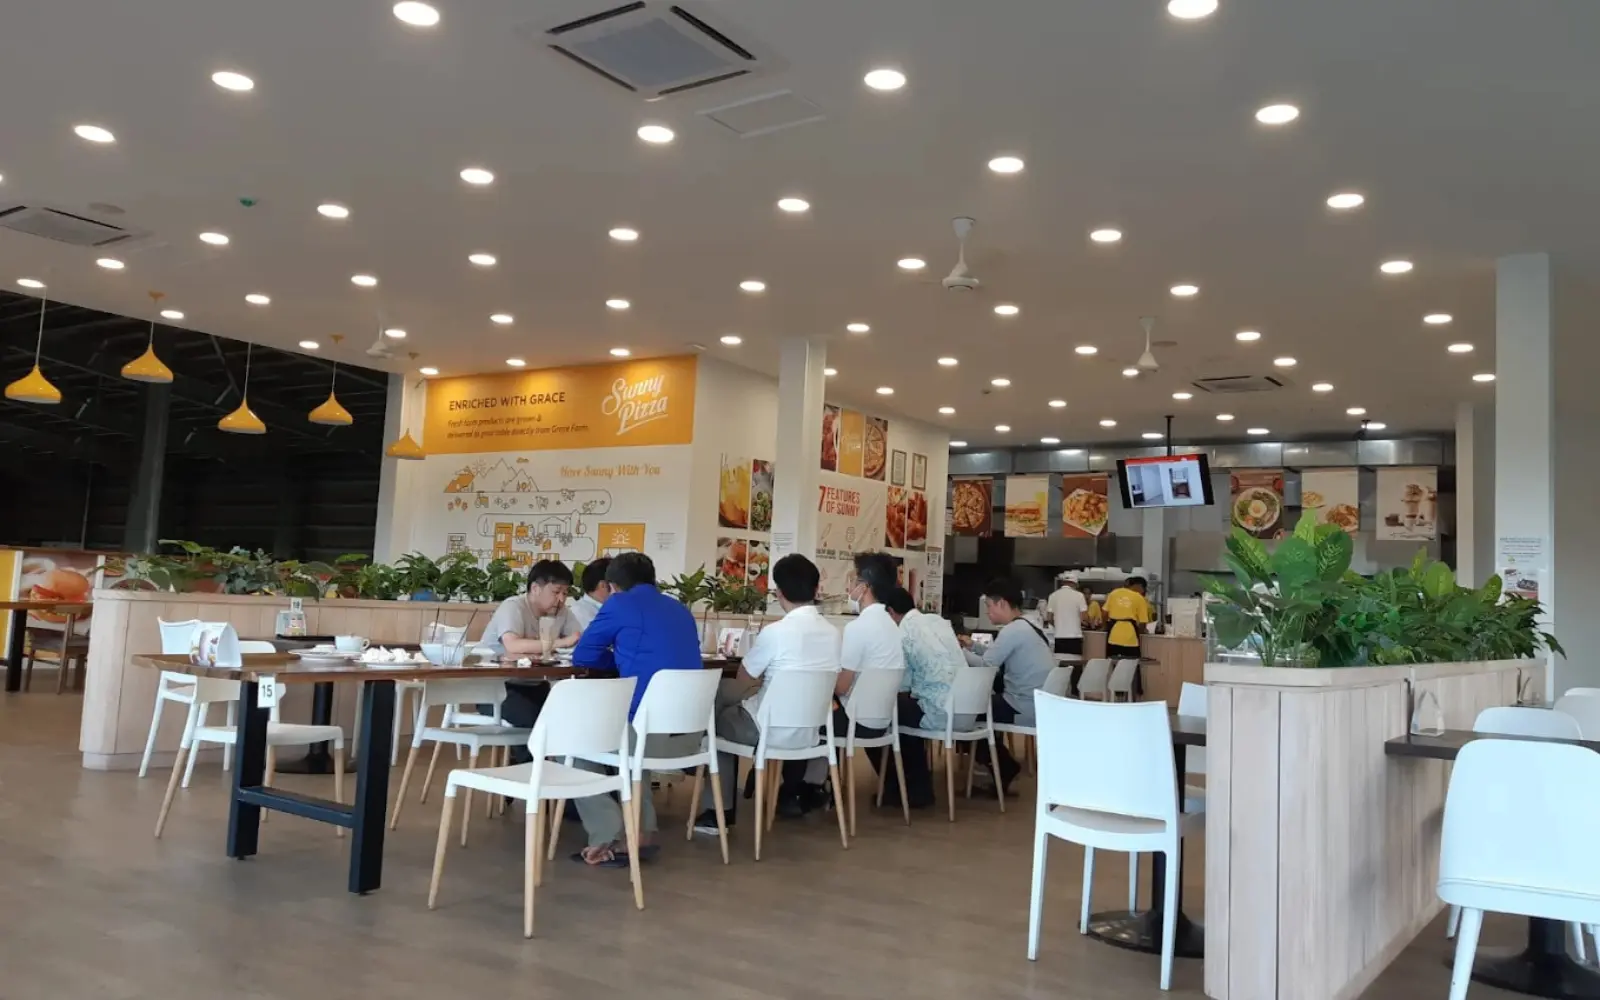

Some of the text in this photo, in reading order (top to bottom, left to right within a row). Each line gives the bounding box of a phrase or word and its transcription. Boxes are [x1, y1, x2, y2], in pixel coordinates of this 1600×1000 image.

[449, 391, 566, 411] ENRICHED WITH GRACE
[601, 374, 665, 415] Sunny
[616, 396, 669, 436] Pizza
[560, 463, 661, 480] Have Sunny With You
[818, 485, 860, 512] 7 FEATURES
[826, 501, 860, 517] OF SUNNY
[261, 684, 273, 698] 15
